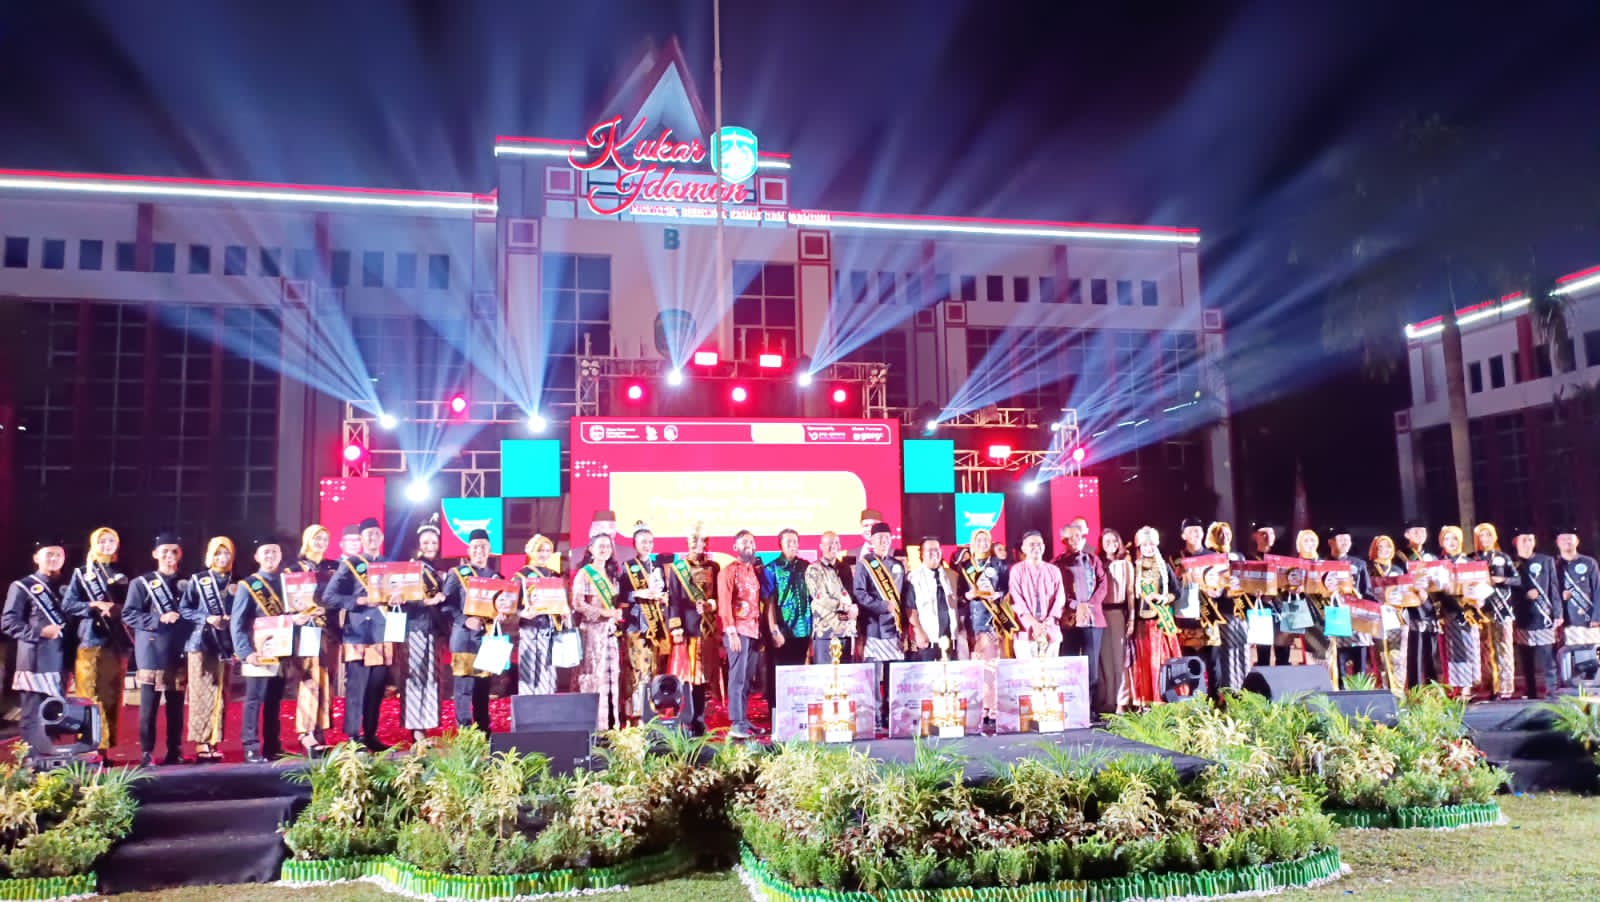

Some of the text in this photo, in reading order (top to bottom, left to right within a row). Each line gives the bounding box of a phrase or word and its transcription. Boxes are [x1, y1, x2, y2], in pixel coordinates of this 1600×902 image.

[568, 115, 706, 172] Kukar
[586, 163, 749, 215] Idaman
[663, 228, 681, 250] B
